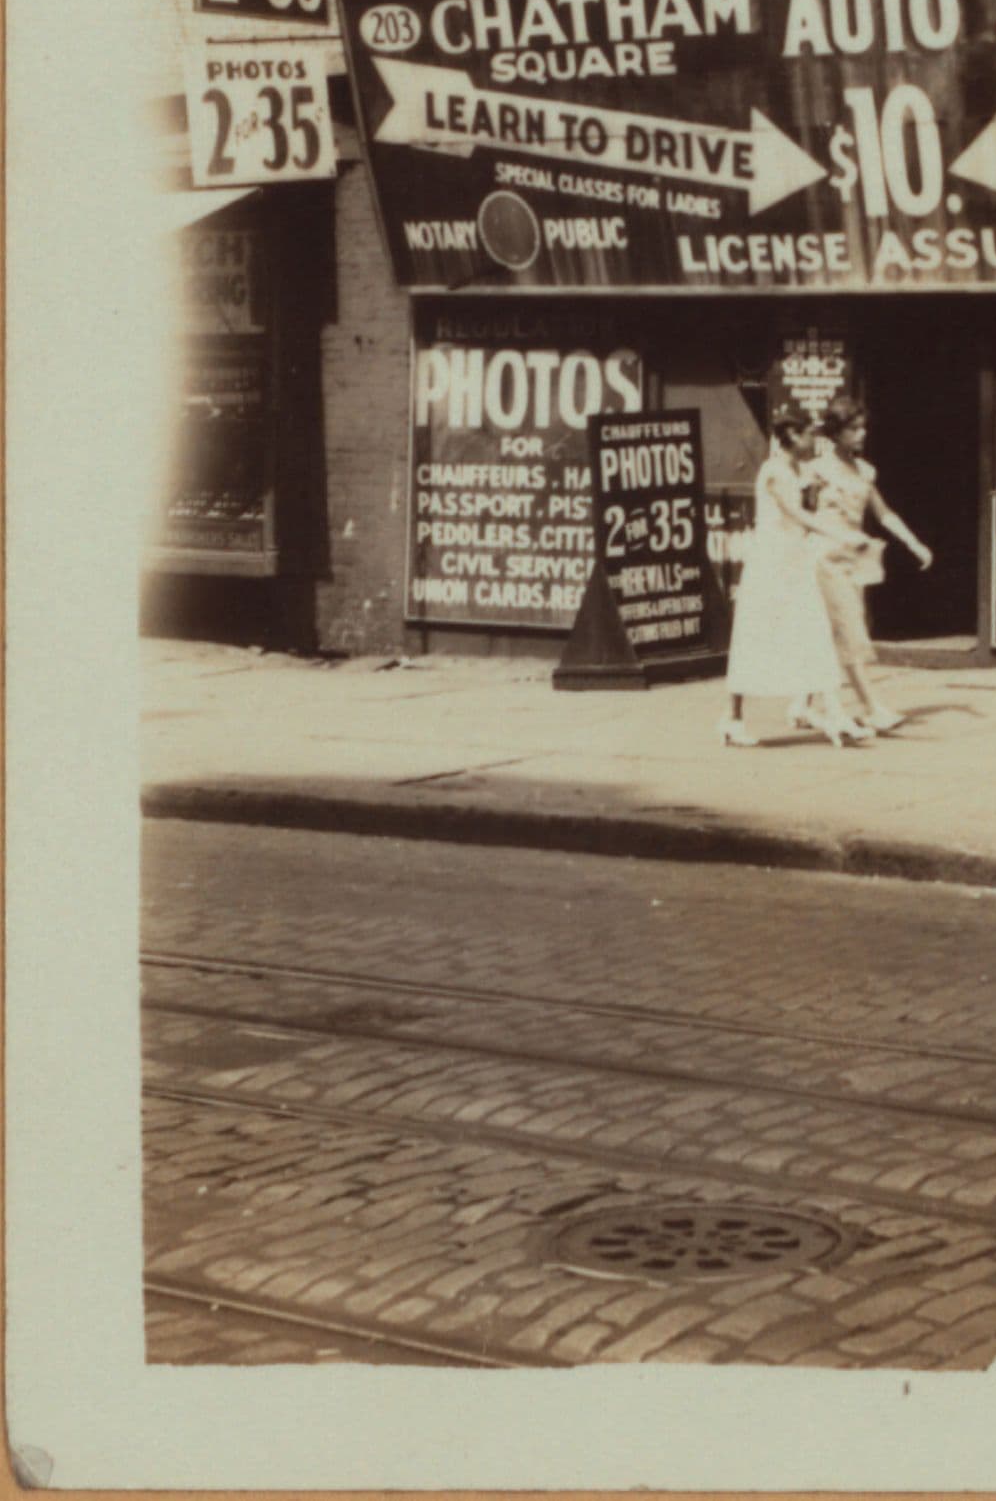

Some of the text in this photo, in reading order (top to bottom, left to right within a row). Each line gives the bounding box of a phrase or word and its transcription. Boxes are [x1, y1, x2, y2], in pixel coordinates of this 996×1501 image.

[371, 9, 416, 45] 203
[206, 59, 307, 83] PHOTOS
[490, 40, 678, 85] SQUARE
[201, 87, 237, 177] 2
[425, 90, 756, 180] LEARN TO DRIVE
[495, 161, 556, 193] SPECIAL
[558, 173, 625, 204] CLASSES
[626, 184, 661, 210] FOR
[403, 216, 628, 252] NOTARY PUBLIC
[678, 232, 852, 274] LICENSE
[415, 347, 644, 430] PHOTOS
[500, 436, 544, 458] FOR
[600, 420, 691, 441] CHAUFFEURS
[563, 466, 592, 491] HA
[600, 441, 696, 493] PHOTOS
[603, 504, 626, 558] 2
[440, 552, 500, 577] CIVIL
[412, 578, 469, 604] UNION
